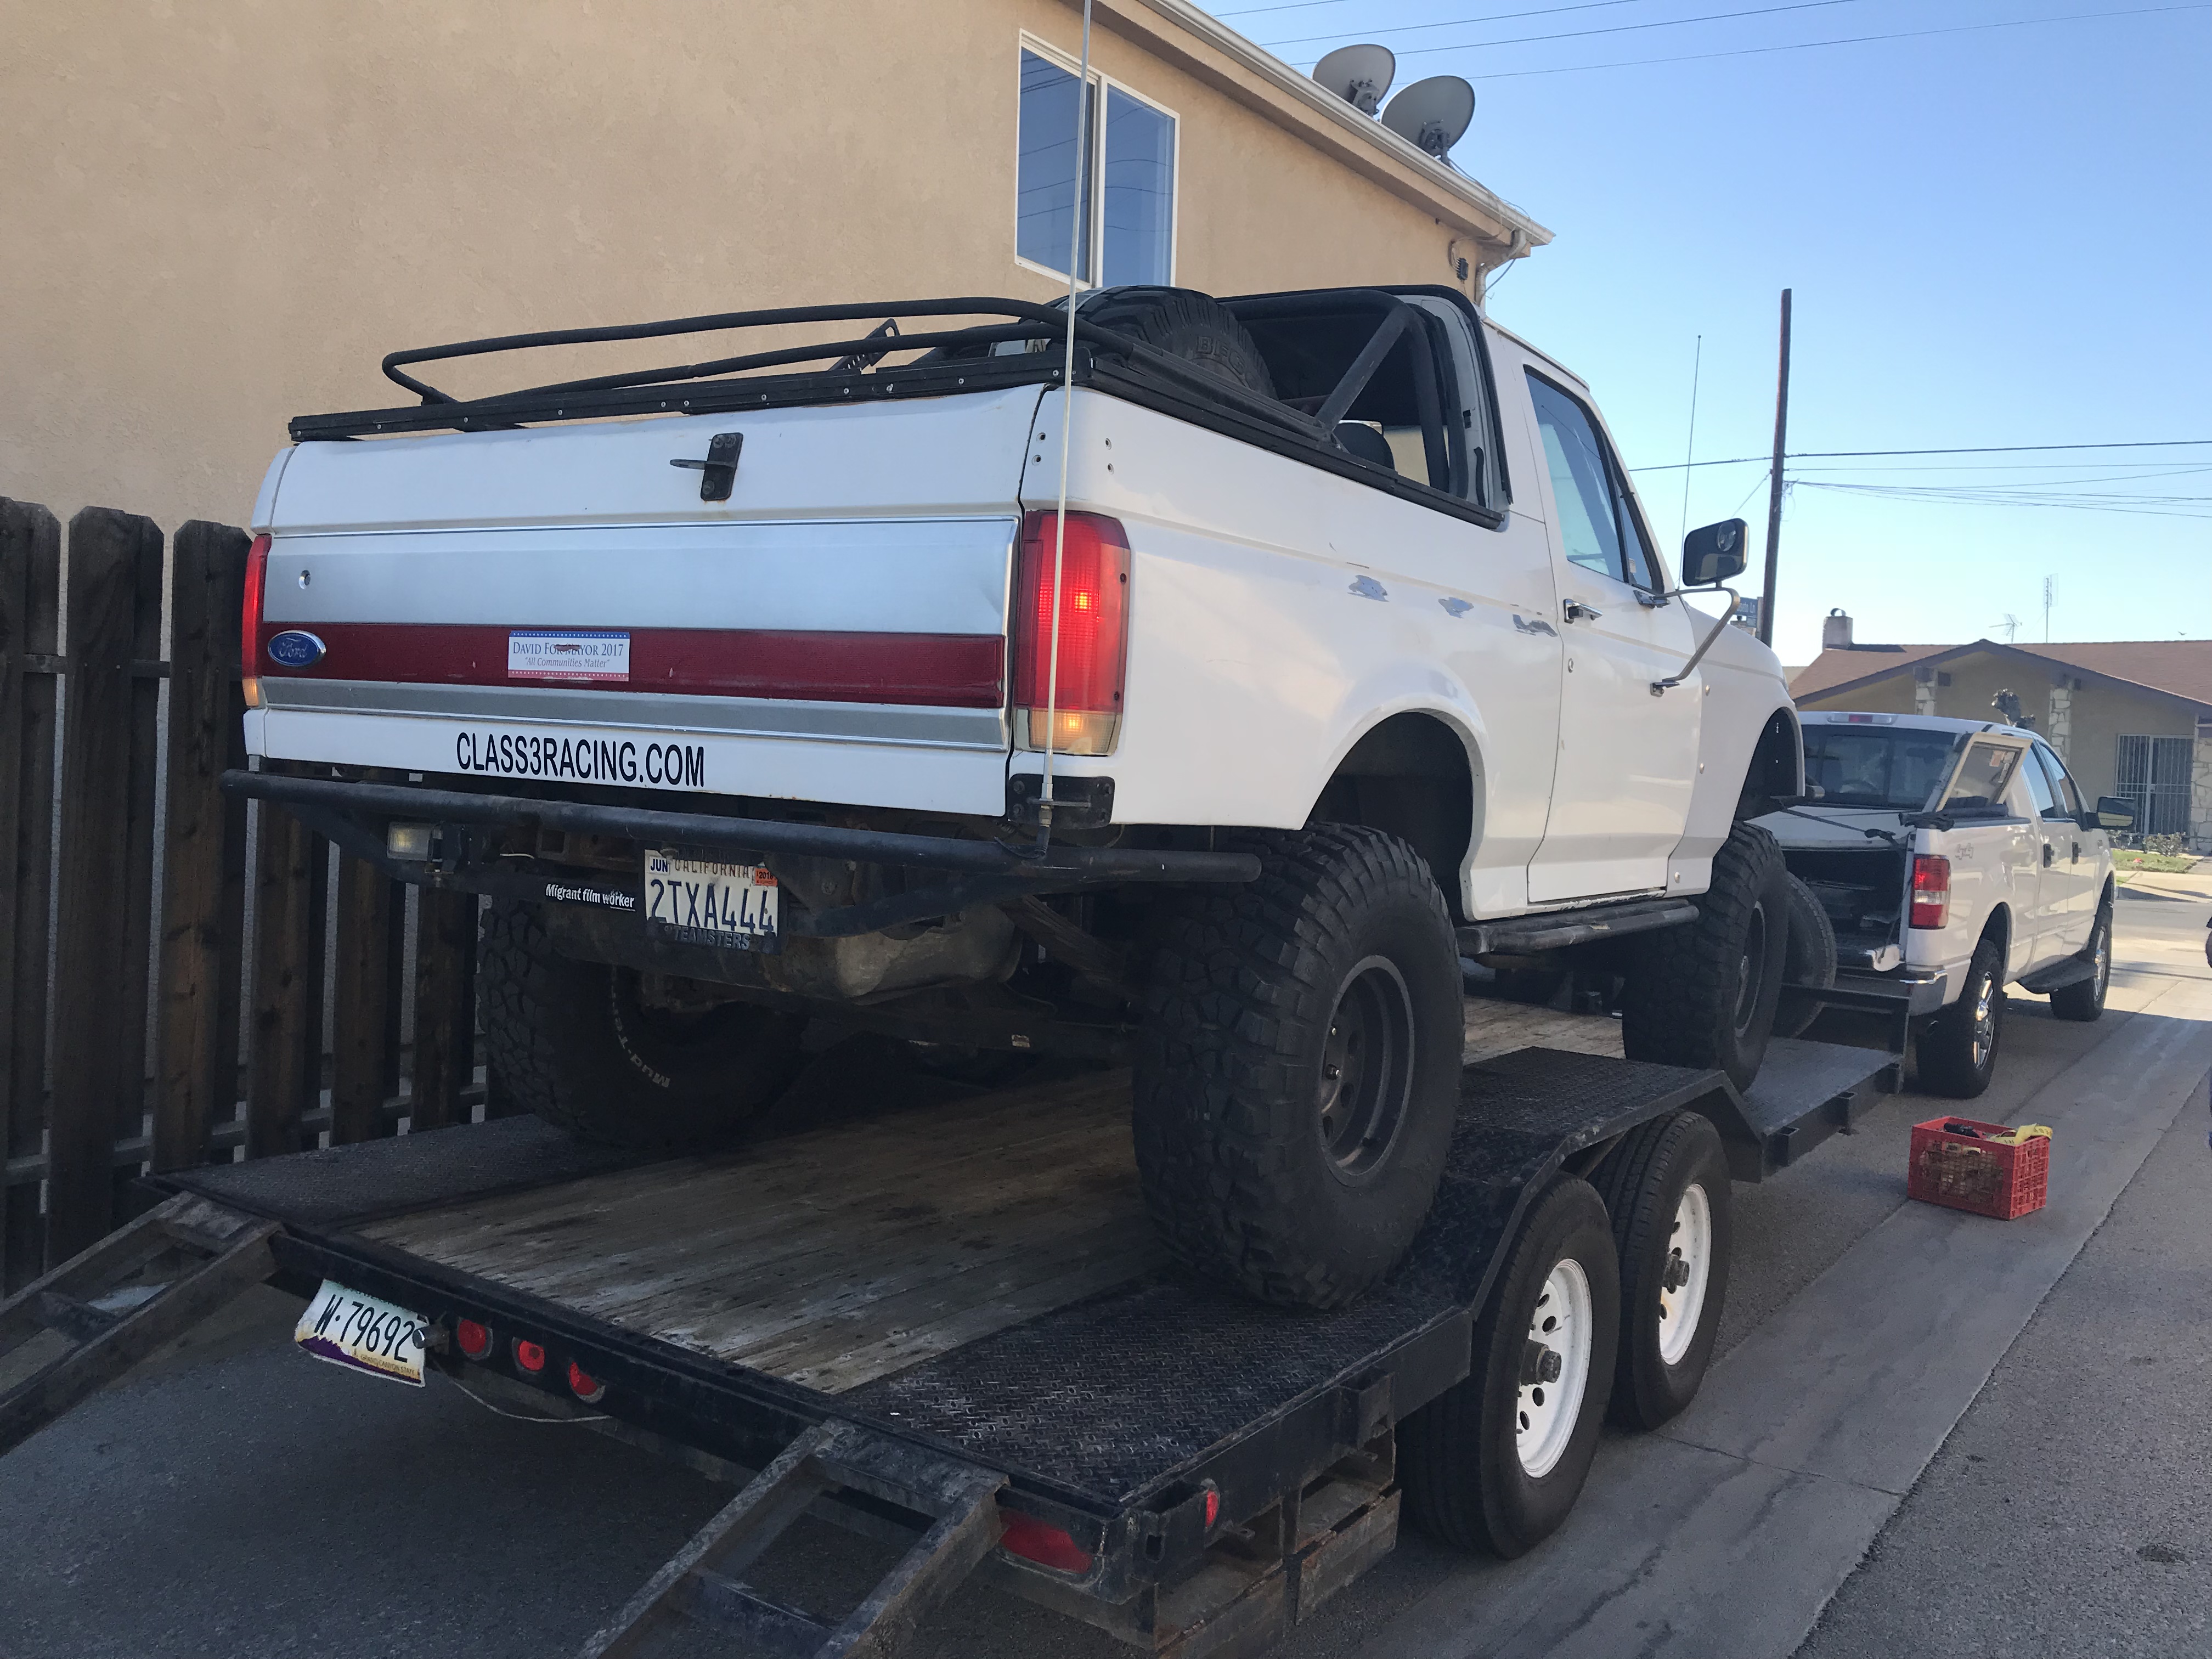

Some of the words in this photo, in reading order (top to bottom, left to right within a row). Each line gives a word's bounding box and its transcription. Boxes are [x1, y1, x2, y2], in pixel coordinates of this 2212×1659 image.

[279, 637, 308, 658] Ford
[513, 641, 541, 654] DAVID
[601, 644, 624, 656] 2017
[537, 657, 582, 667] Communities
[584, 659, 610, 668] Matter"
[456, 731, 704, 788] CLASS3RACING.COM
[650, 858, 669, 873] JUN
[675, 861, 749, 879] CALIFORNIA
[545, 884, 581, 900] Migrant
[583, 888, 600, 903] film
[603, 893, 635, 908] worker
[650, 879, 774, 932] 2TXA444
[674, 925, 751, 950] TEAMSTERS
